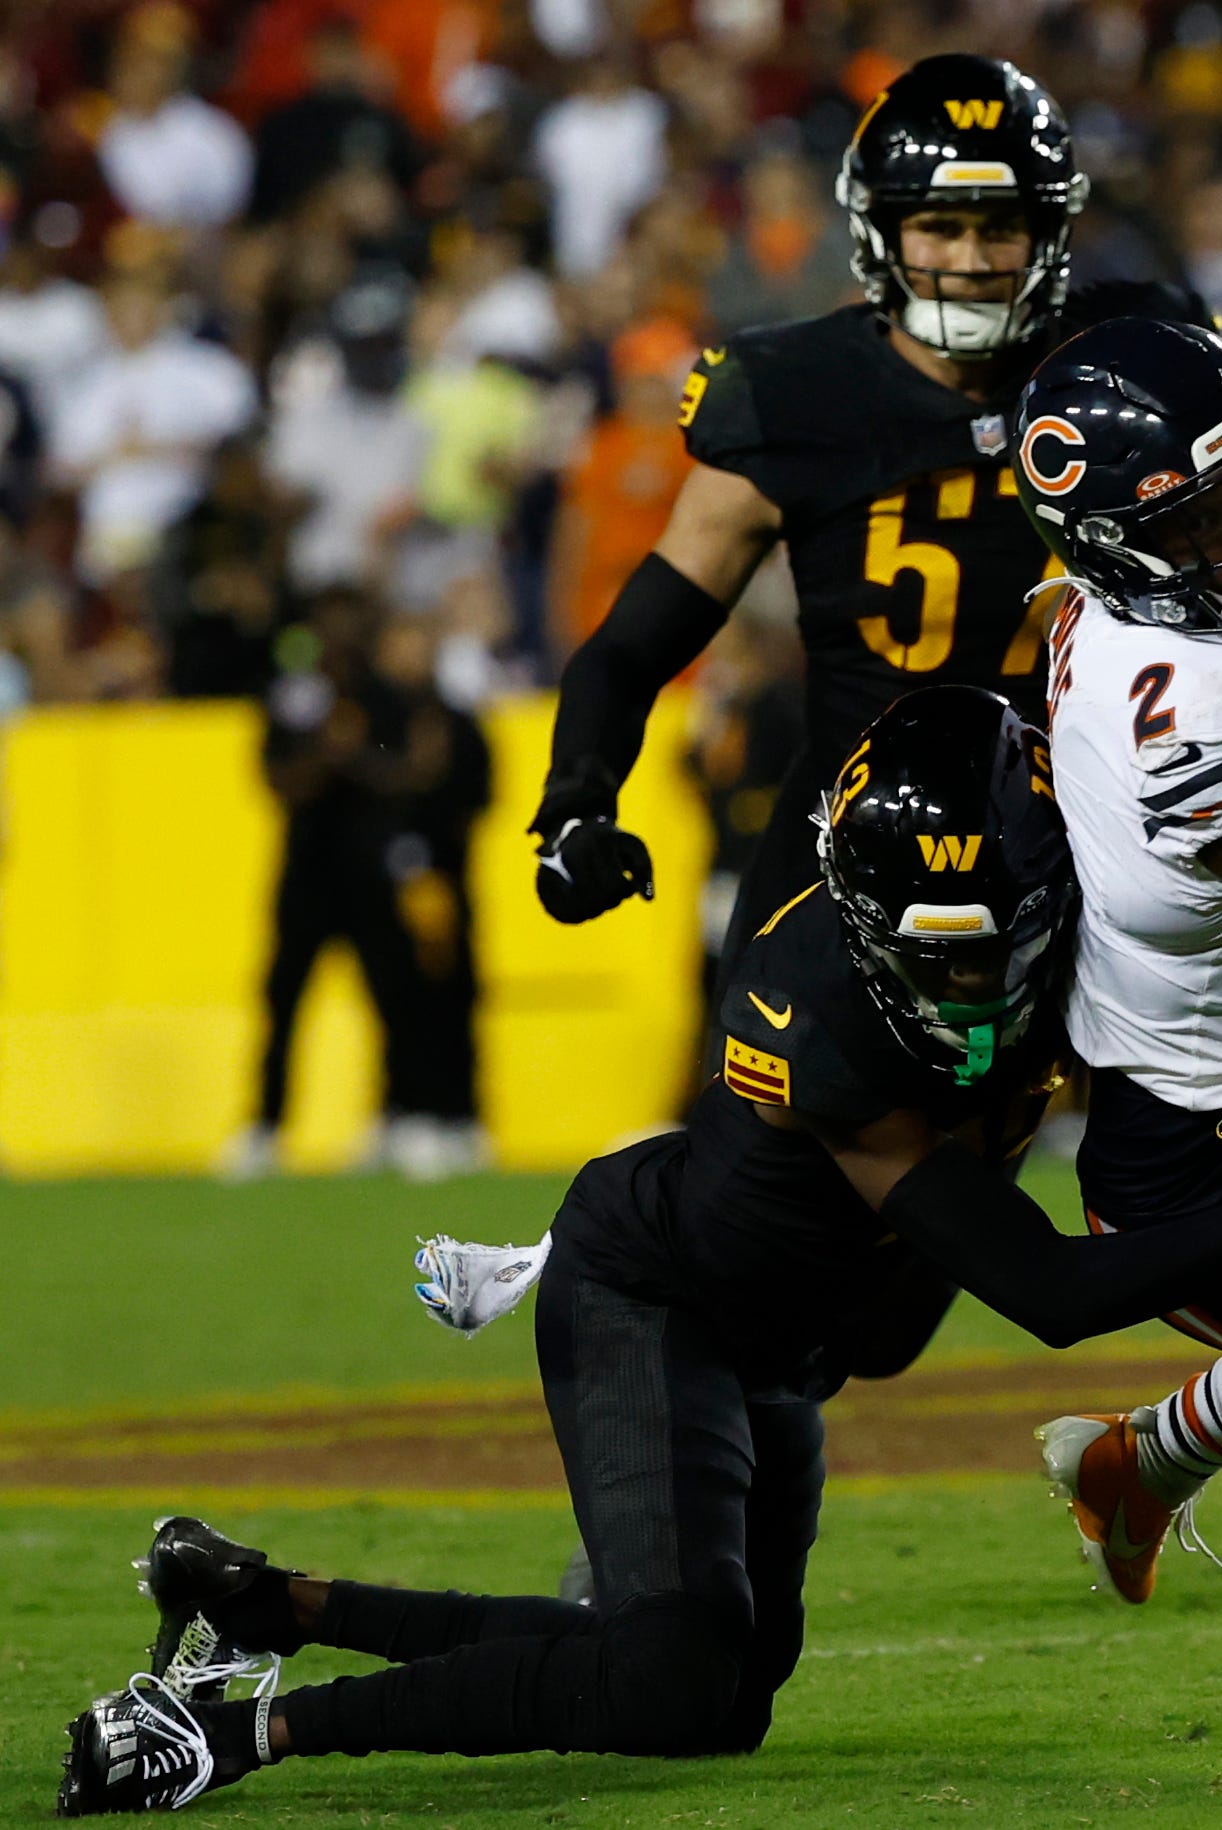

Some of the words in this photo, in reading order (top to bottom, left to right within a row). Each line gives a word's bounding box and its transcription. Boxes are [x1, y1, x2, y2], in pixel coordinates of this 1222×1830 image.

[943, 99, 1005, 130] W
[1018, 414, 1087, 497] C
[856, 467, 1065, 676] 57
[1128, 662, 1177, 750] 2
[915, 834, 984, 873] W
[257, 1701, 268, 1751] SECOND
